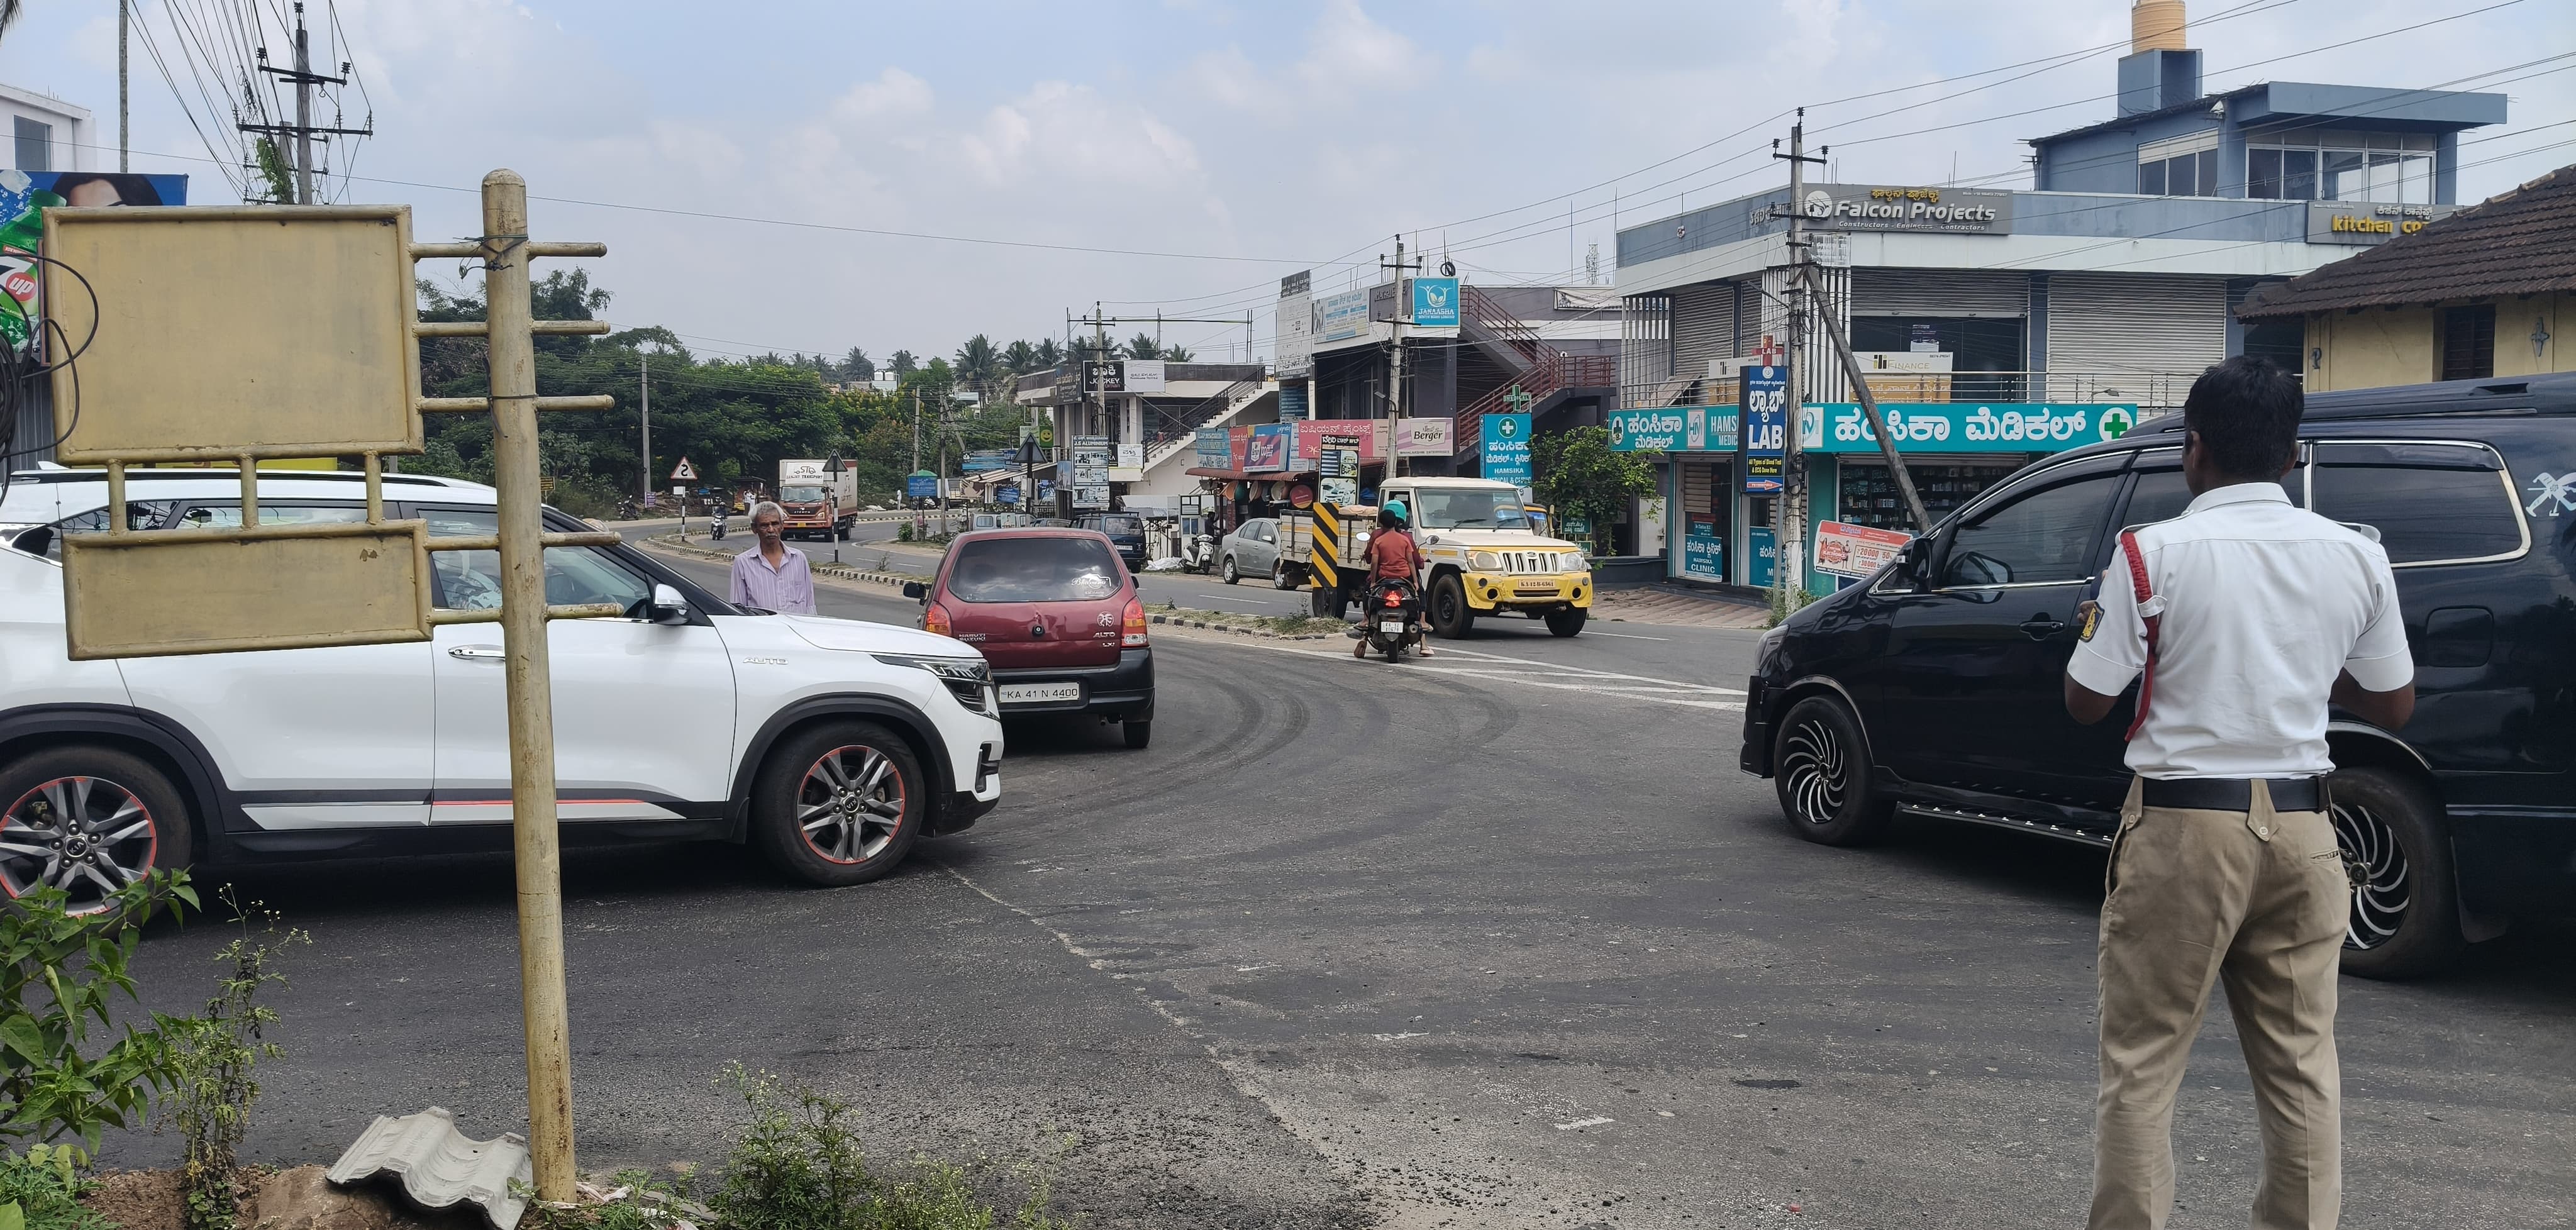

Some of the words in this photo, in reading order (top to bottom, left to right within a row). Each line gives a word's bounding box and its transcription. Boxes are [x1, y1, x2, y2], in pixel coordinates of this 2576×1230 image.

[1835, 201, 1904, 219] Falcon
[1909, 202, 1996, 223] Projects
[1839, 221, 1889, 229] Constructors
[2332, 214, 2394, 233] kitchen
[1887, 359, 1930, 369] FINANCE
[1749, 385, 1785, 423] ಲ್ಯಾಬ್
[1628, 412, 1683, 433] ಹಂಸಿಕಾ
[1835, 407, 1950, 441] ಹಂಸಿಕಾ
[1965, 406, 2087, 441] ಮೆಡಿಕಲ್
[1414, 431, 1443, 441] Berger
[1635, 434, 1674, 449] ಮೆಡಿಕಲ್
[1748, 424, 1784, 450] LAB
[1690, 563, 1716, 573] CLINIC
[742, 657, 789, 665] AUTO
[1007, 691, 1021, 699] KA
[1052, 688, 1078, 697] 4400
